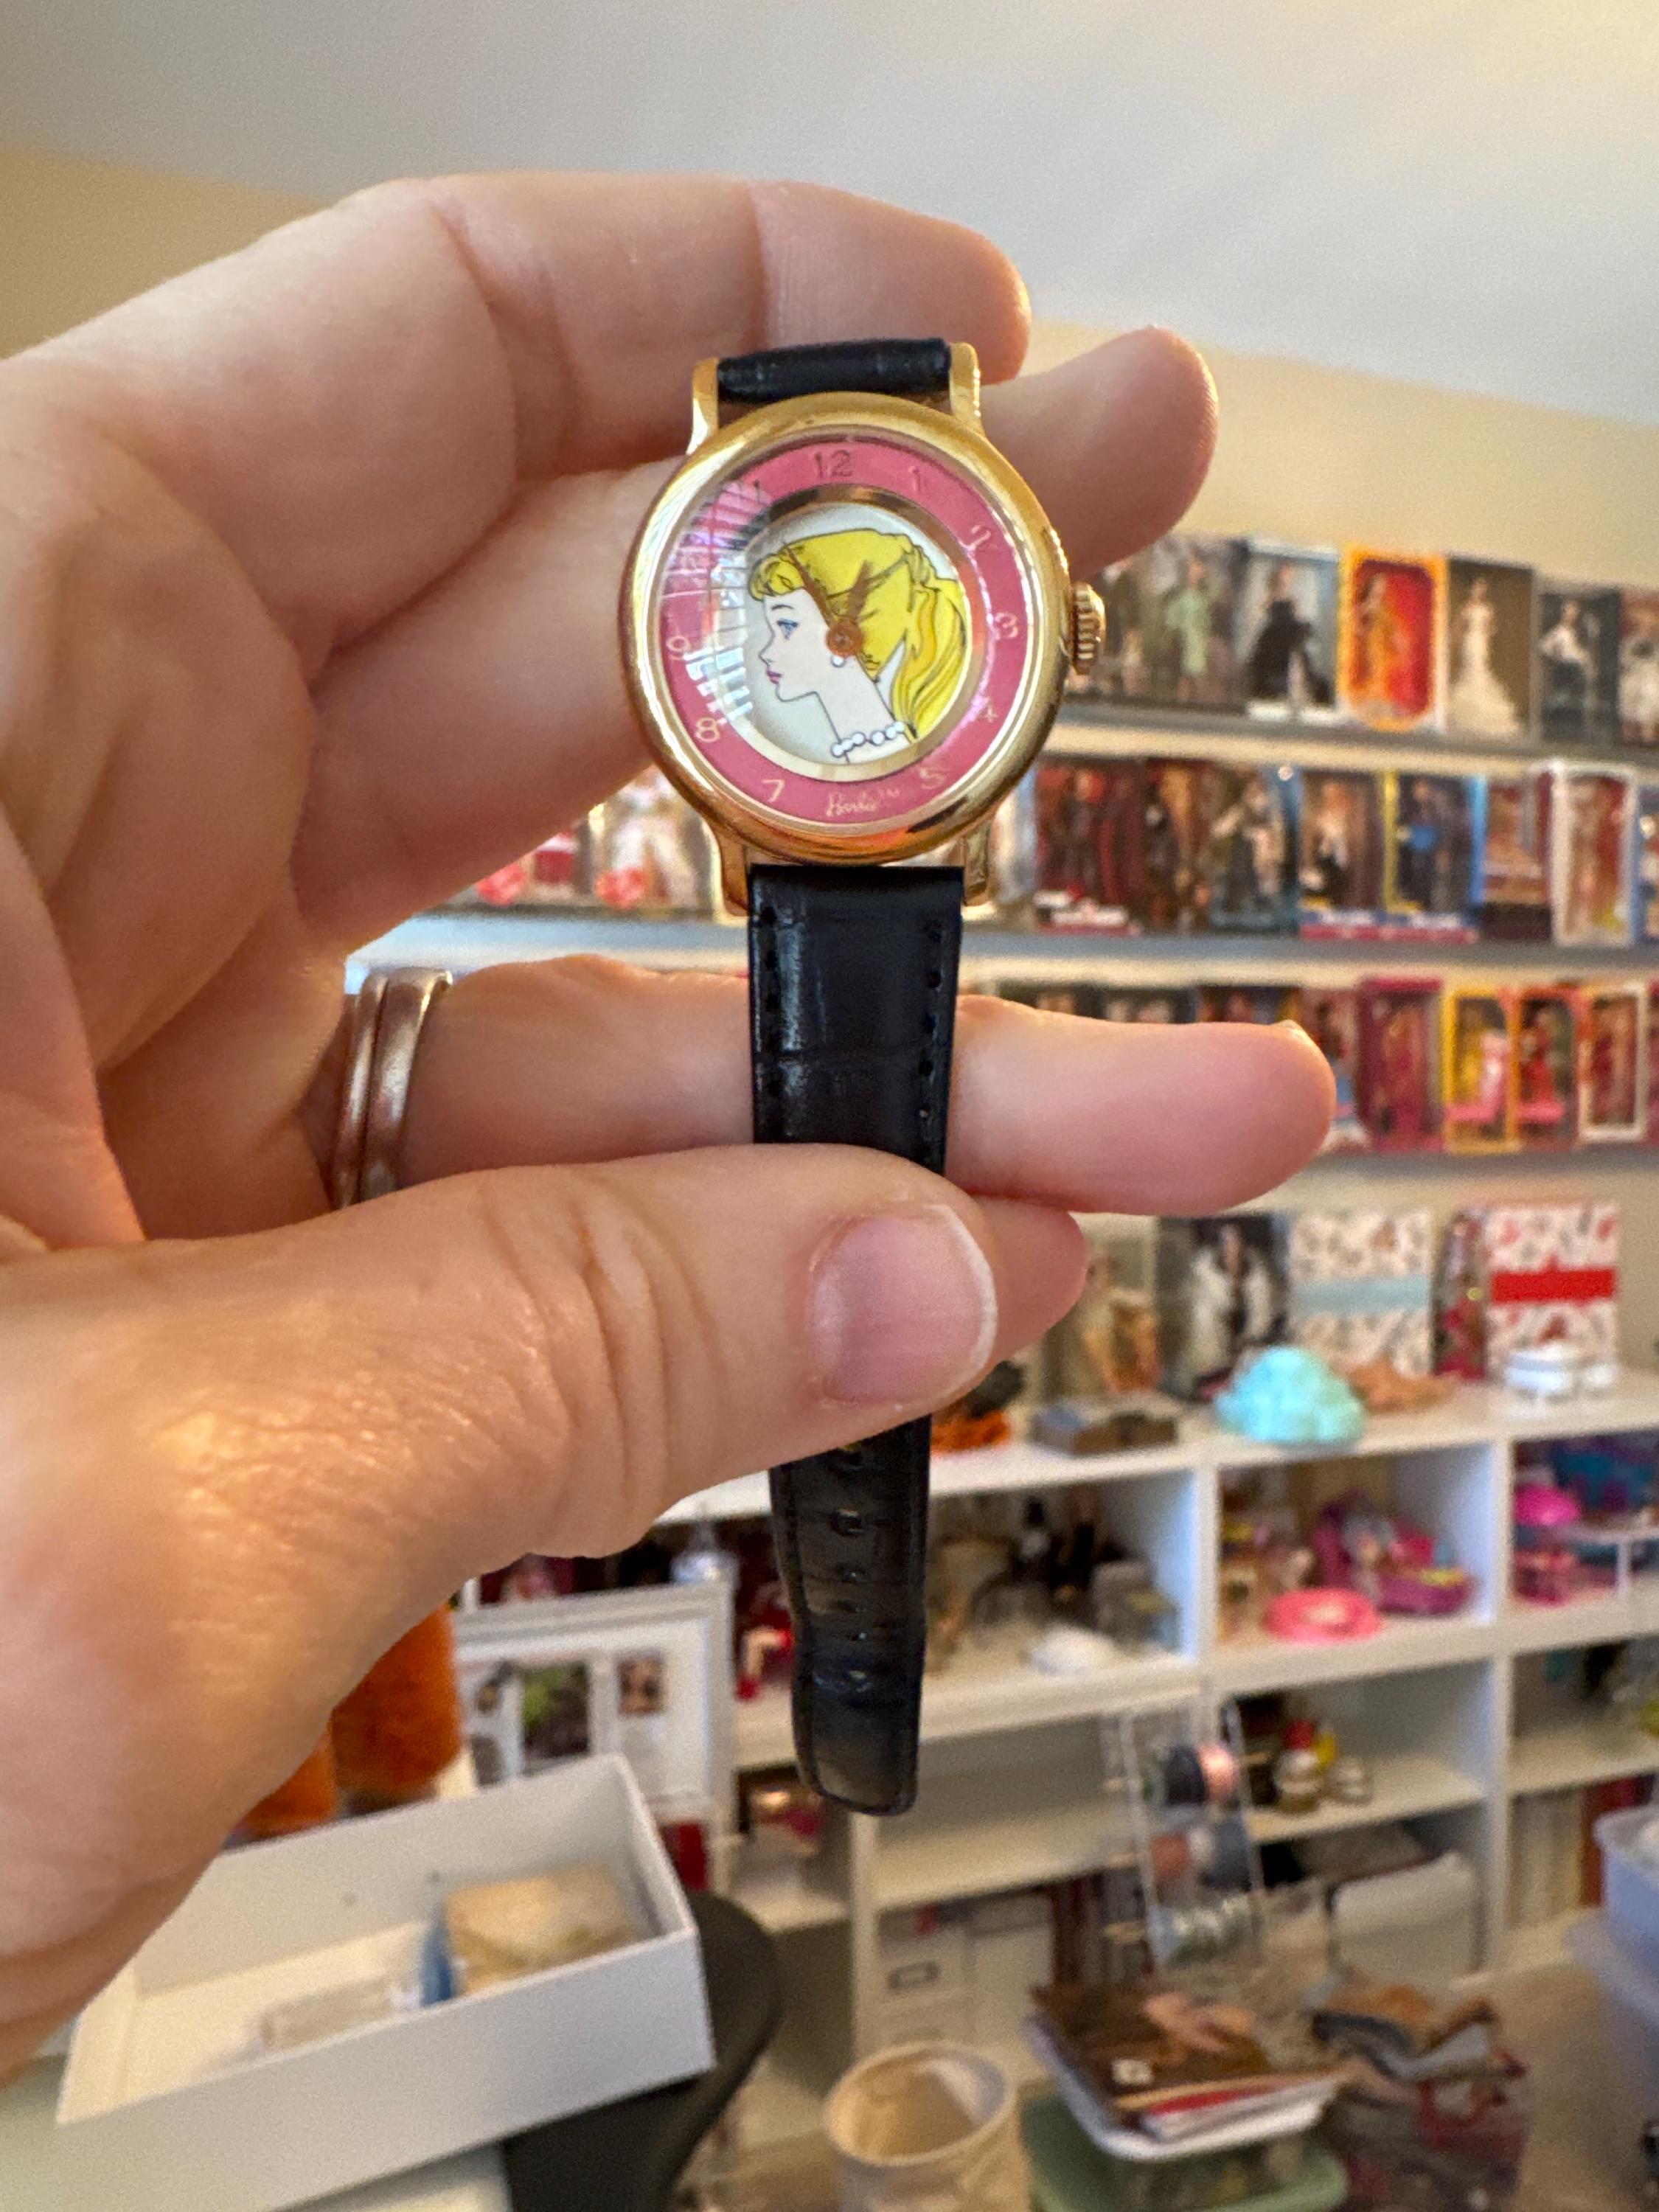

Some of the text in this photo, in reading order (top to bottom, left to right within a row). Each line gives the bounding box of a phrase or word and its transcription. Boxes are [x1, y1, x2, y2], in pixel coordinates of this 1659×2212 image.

[815, 449, 852, 478] 12
[909, 465, 921, 493] 1
[995, 611, 1018, 643] 3
[695, 717, 720, 743] 8
[761, 779, 786, 803] 7
[919, 765, 950, 790] 5
